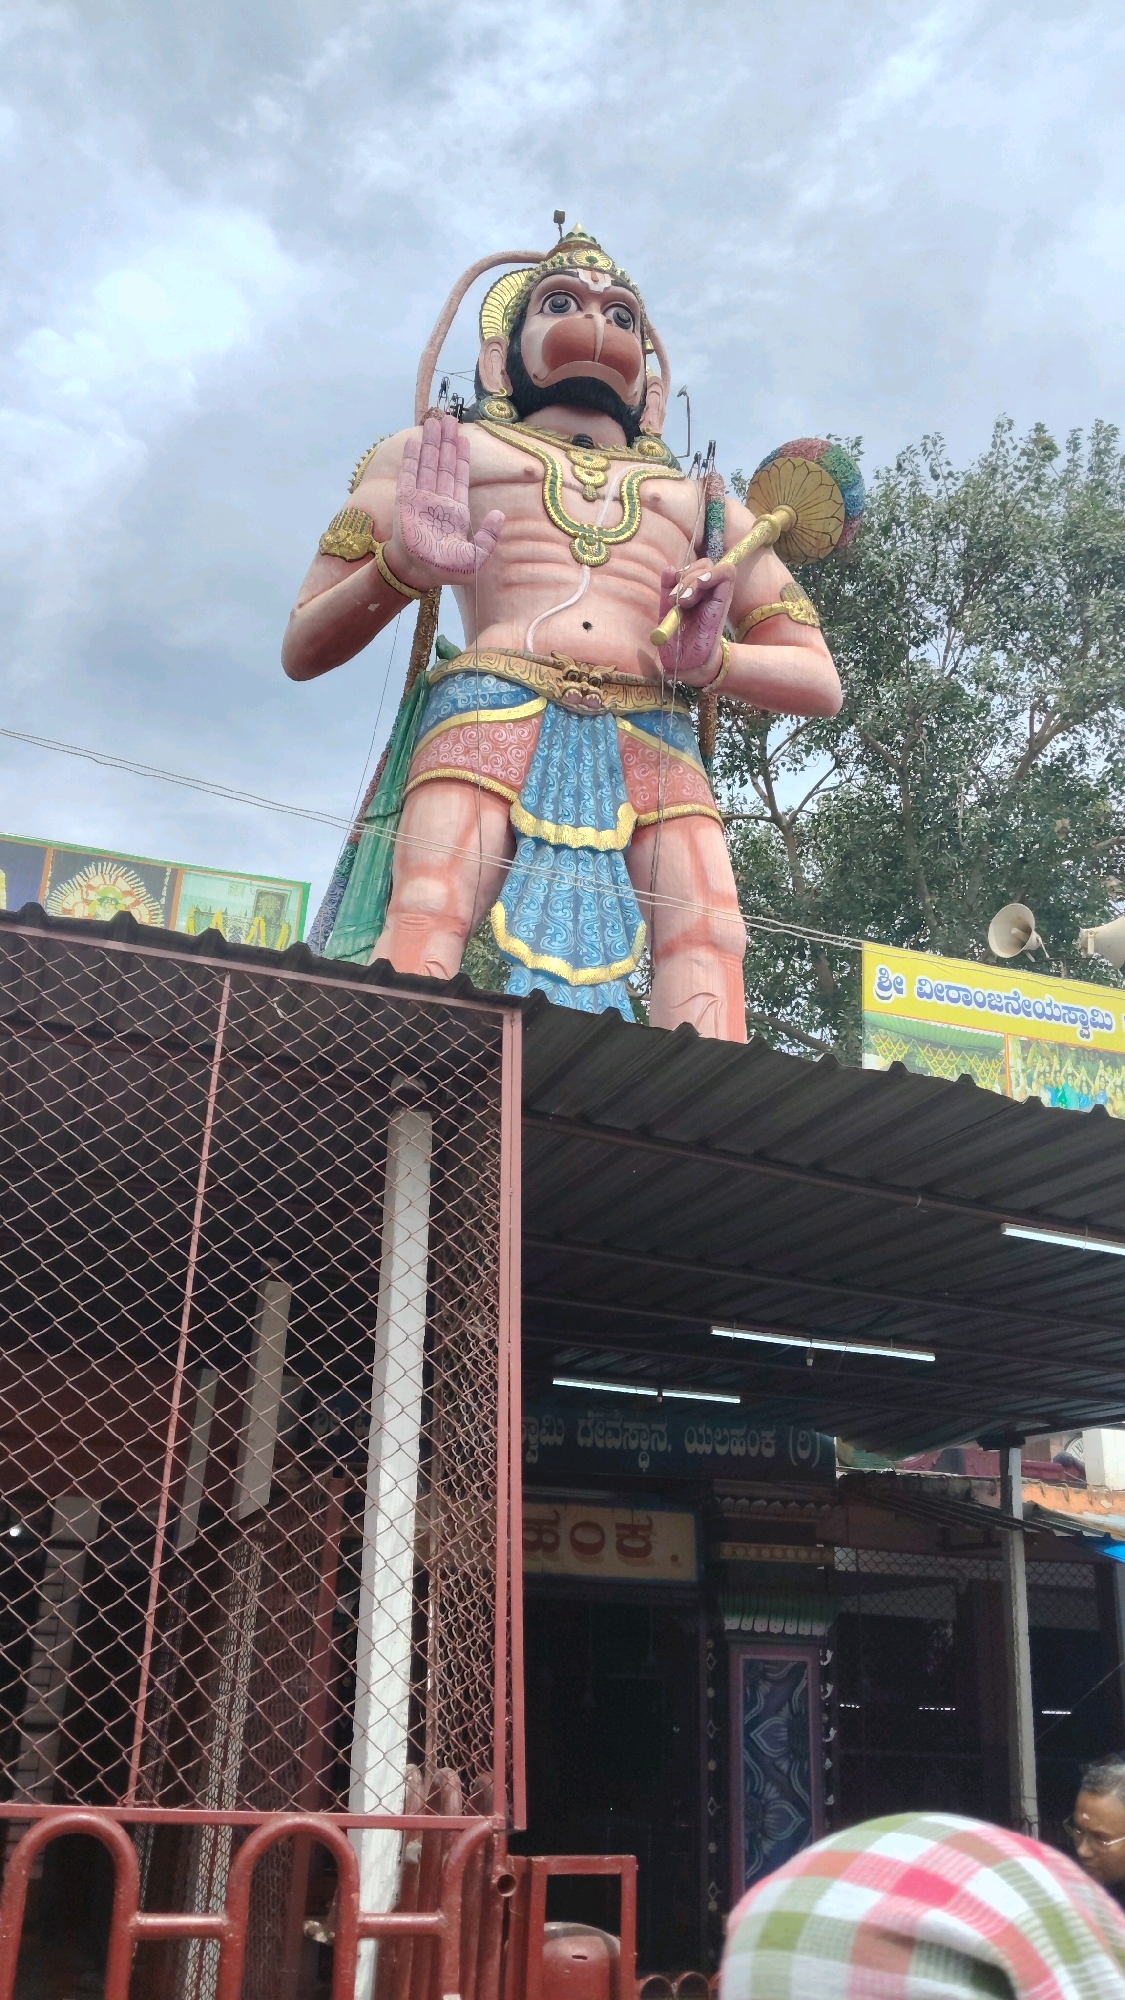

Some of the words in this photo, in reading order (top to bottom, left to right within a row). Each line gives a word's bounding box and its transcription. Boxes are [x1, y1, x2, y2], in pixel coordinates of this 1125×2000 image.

[875, 967, 904, 1000] ಶ್ರೀ
[916, 978, 1113, 1039] ವೀರಾಂಜನೇಯಸ್ವಾಮಿ
[685, 1420, 776, 1458] ಯಲಹಂಕ
